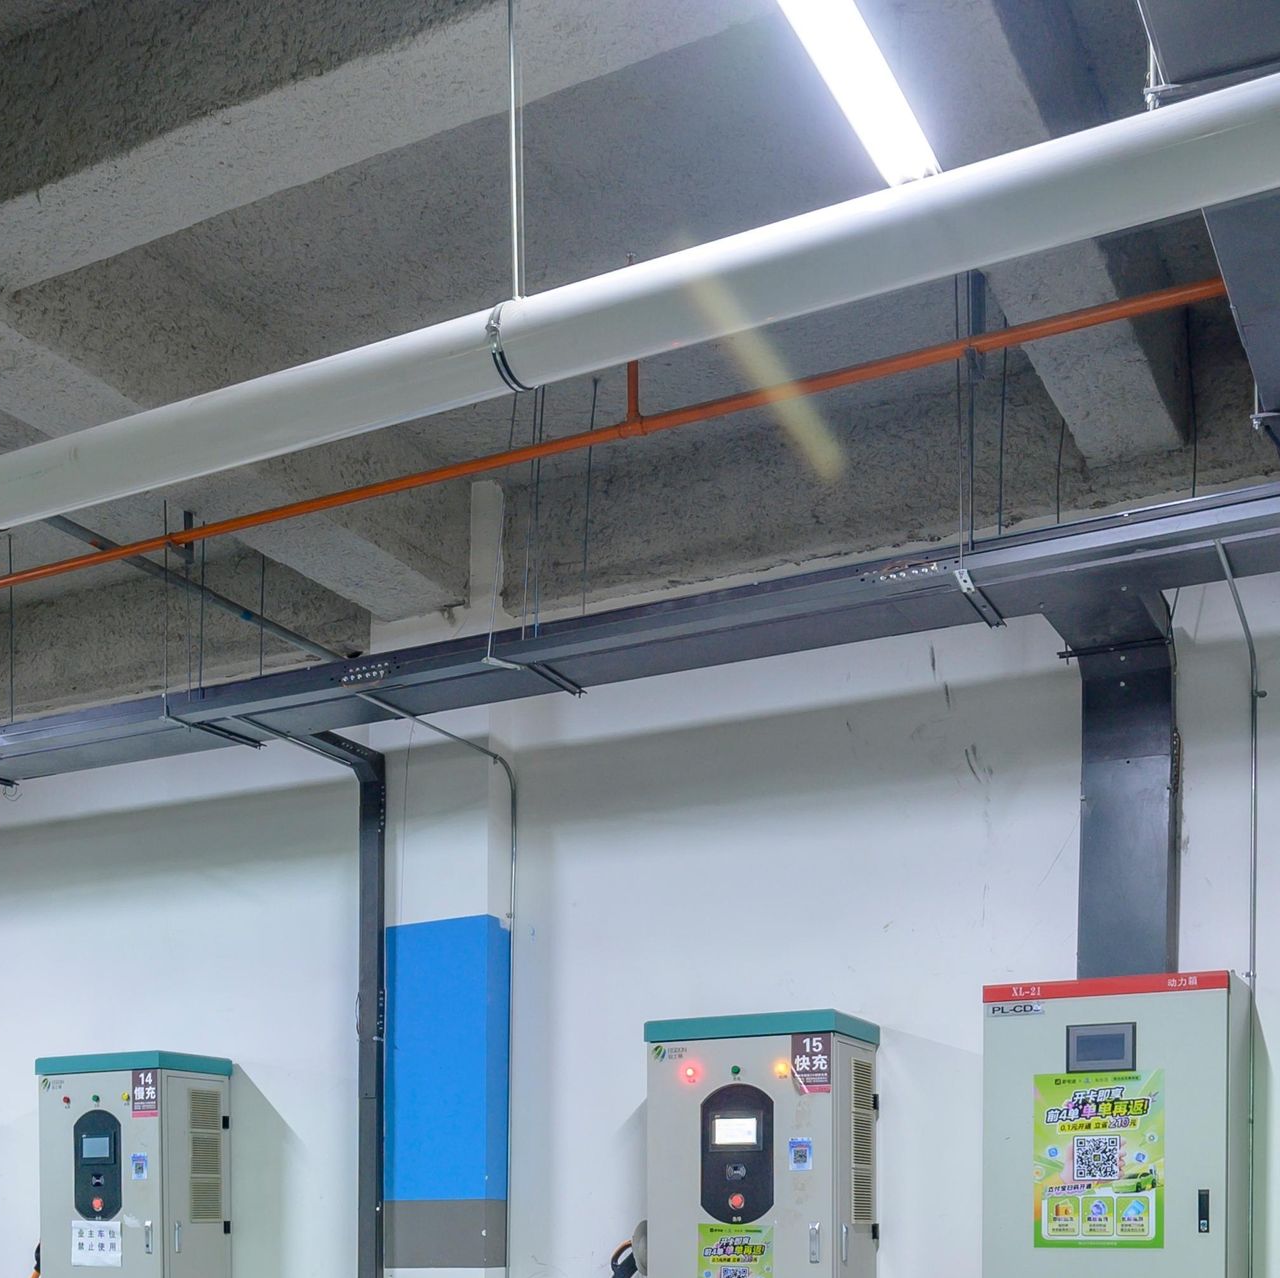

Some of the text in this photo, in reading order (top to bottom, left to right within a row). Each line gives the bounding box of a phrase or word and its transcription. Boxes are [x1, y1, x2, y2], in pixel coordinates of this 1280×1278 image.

[1167, 975, 1198, 987] 动力箱
[1011, 986, 1041, 996] XL-21
[802, 1036, 823, 1053] 15
[794, 1054, 828, 1071] 快充
[139, 1072, 153, 1085] 14
[134, 1086, 157, 1100] 慢充
[1072, 1087, 1124, 1104] 开卡即享
[77, 1241, 117, 1252] 禁止使用
